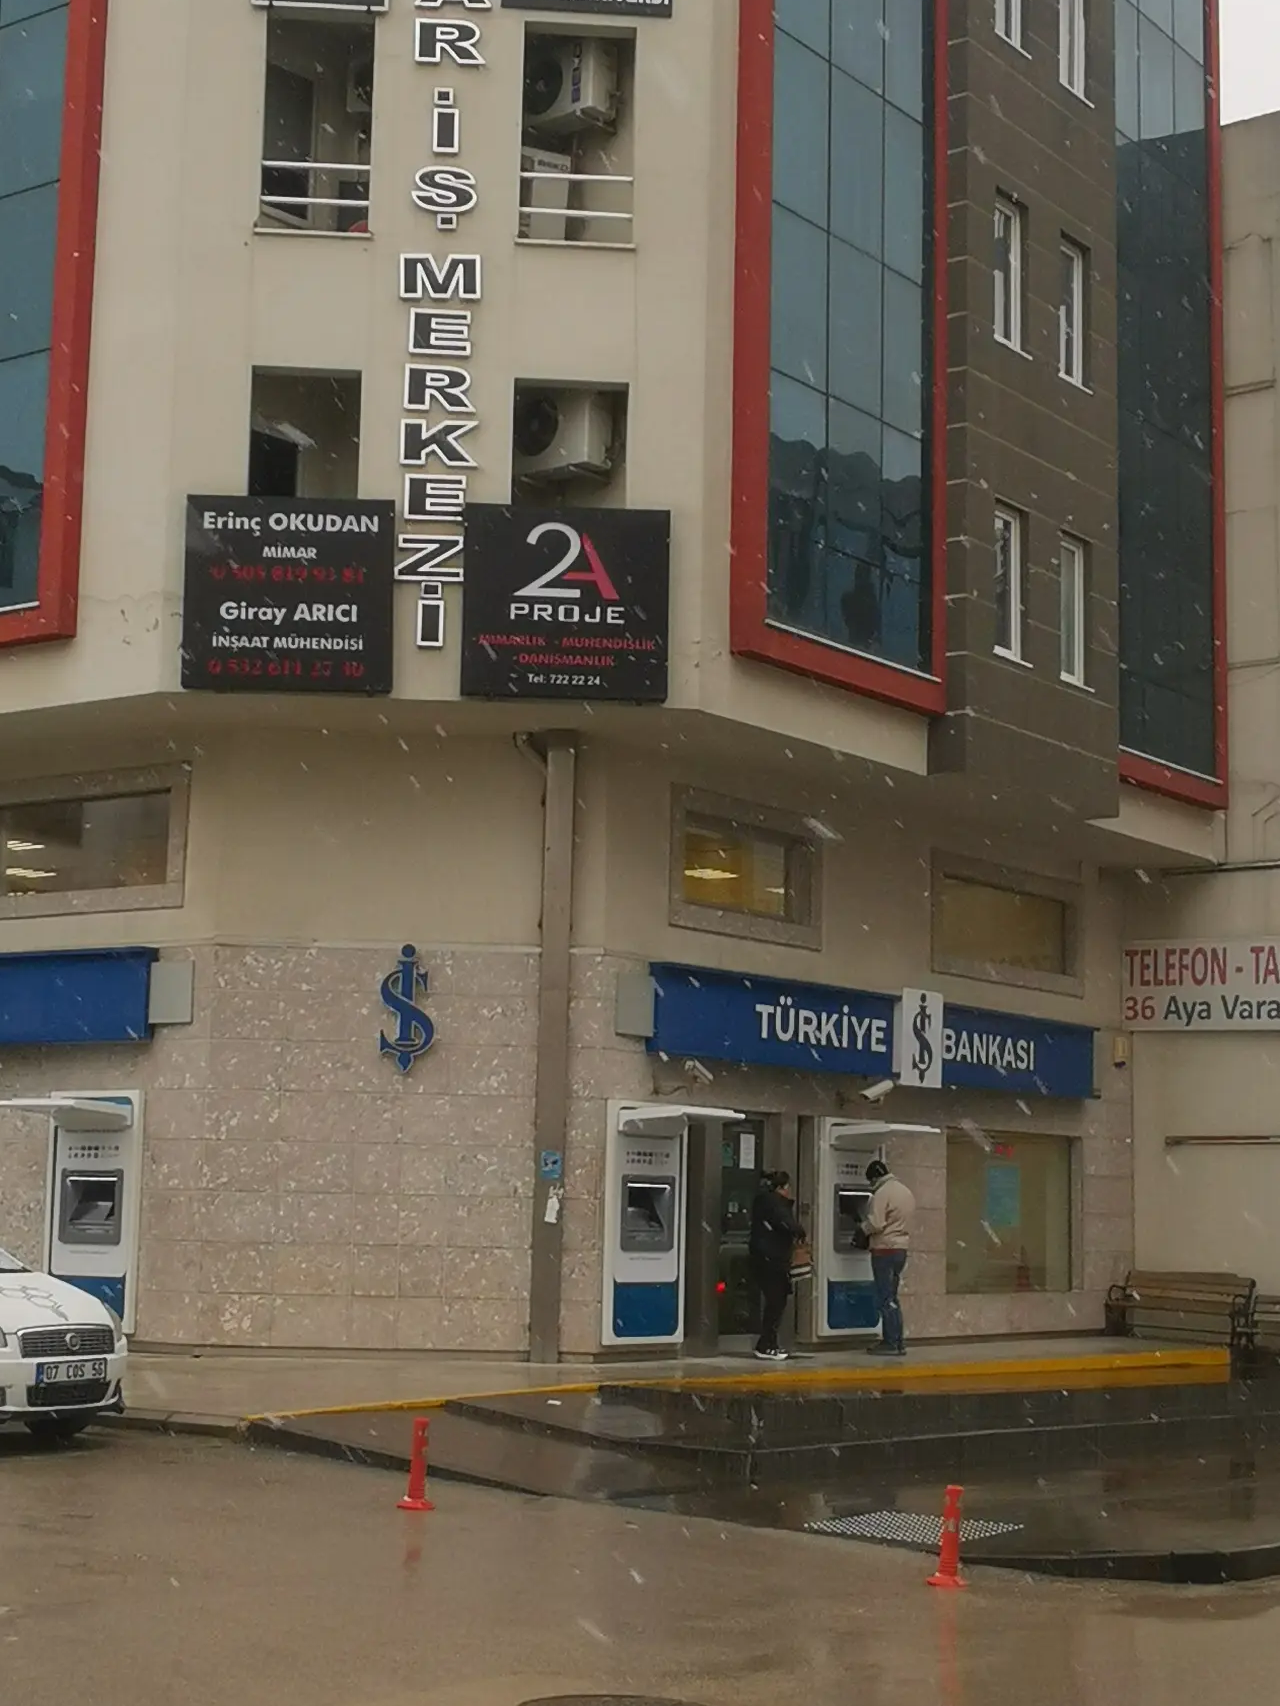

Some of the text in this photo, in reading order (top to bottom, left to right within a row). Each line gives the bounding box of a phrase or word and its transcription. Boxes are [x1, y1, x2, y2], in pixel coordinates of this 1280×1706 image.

[394, 253, 481, 647] MERKEZİ
[203, 511, 379, 536] Erinç OKUDAN
[513, 522, 619, 600] 2A
[219, 601, 358, 625] Giray ARICI
[510, 603, 625, 624] PROJE
[212, 632, 363, 652] İNŞAAT MÜHENDİSİ
[549, 674, 569, 685] 722
[571, 675, 585, 685] 22
[1124, 947, 1227, 987] TELEFON
[1124, 995, 1156, 1021] 36
[1163, 995, 1212, 1026] Aya
[755, 995, 887, 1053] TÜRKİYE
[942, 1028, 1035, 1071] BANKASI
[46, 1365, 59, 1380] 07
